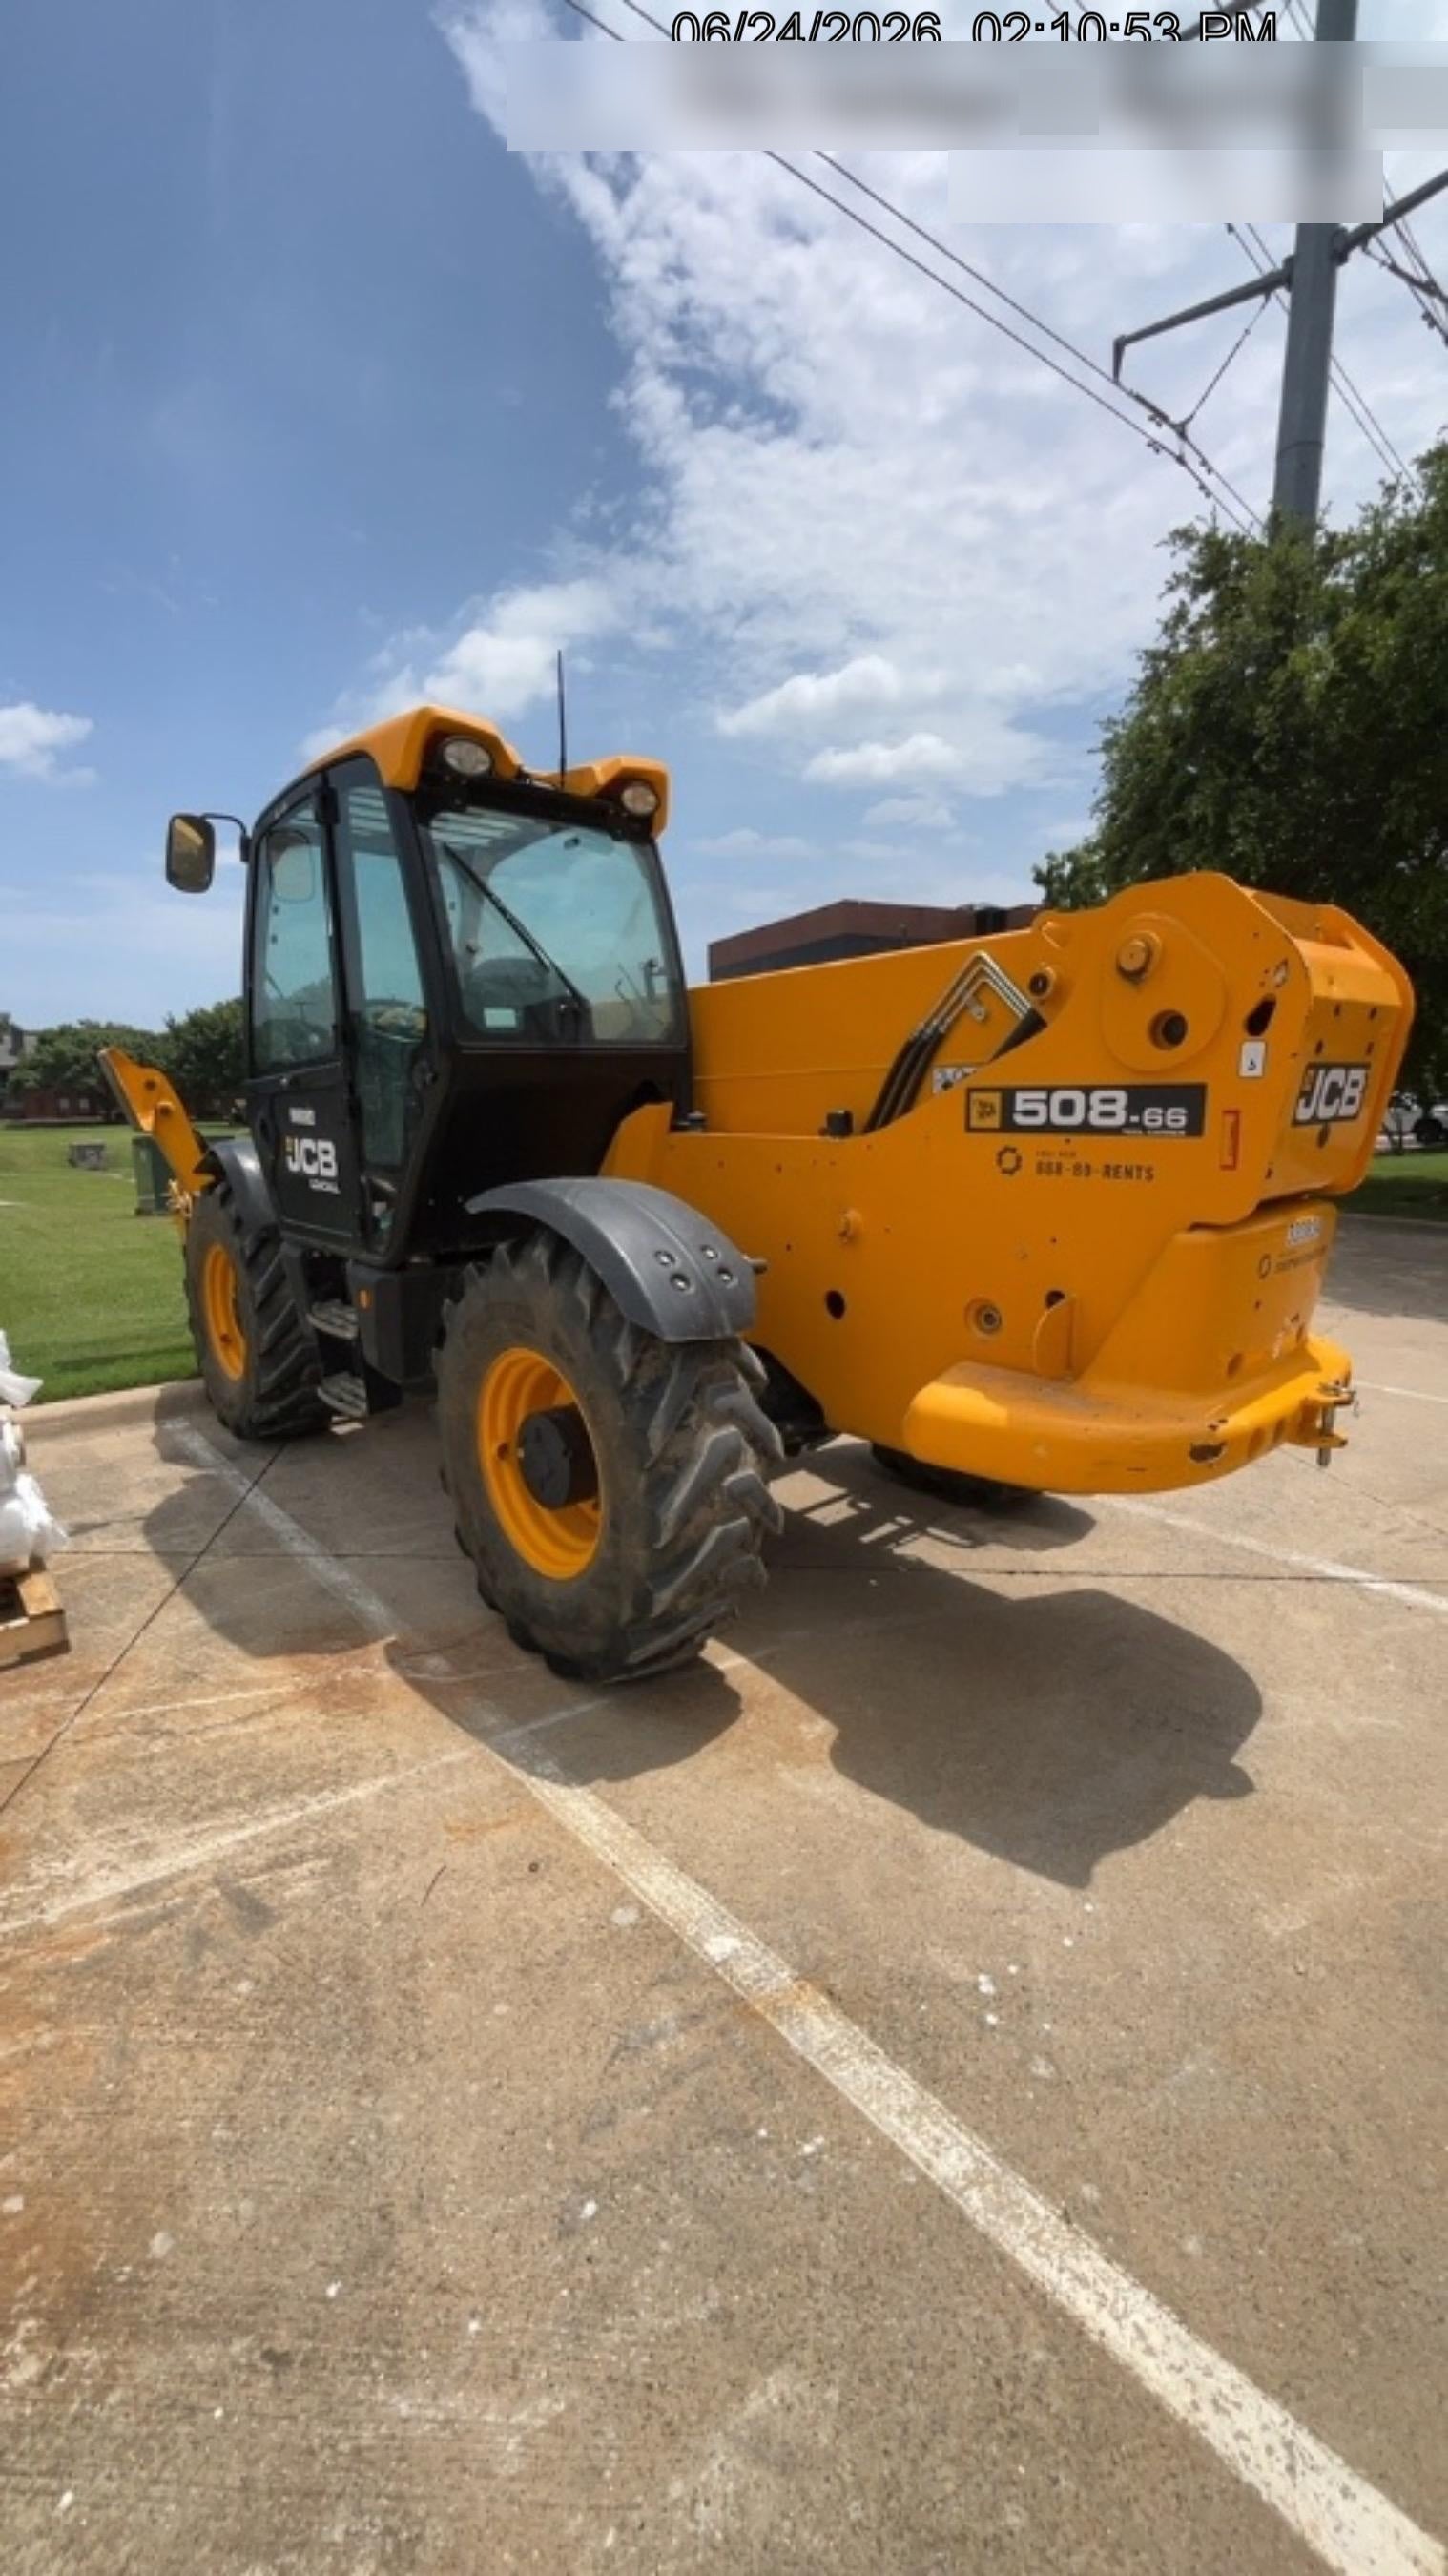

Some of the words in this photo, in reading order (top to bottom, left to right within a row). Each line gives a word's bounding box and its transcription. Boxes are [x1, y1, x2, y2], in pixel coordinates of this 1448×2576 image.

[1012, 1090, 1188, 1128] 508-66
[1295, 1067, 1367, 1121] JCB
[286, 1136, 338, 1177] JCB
